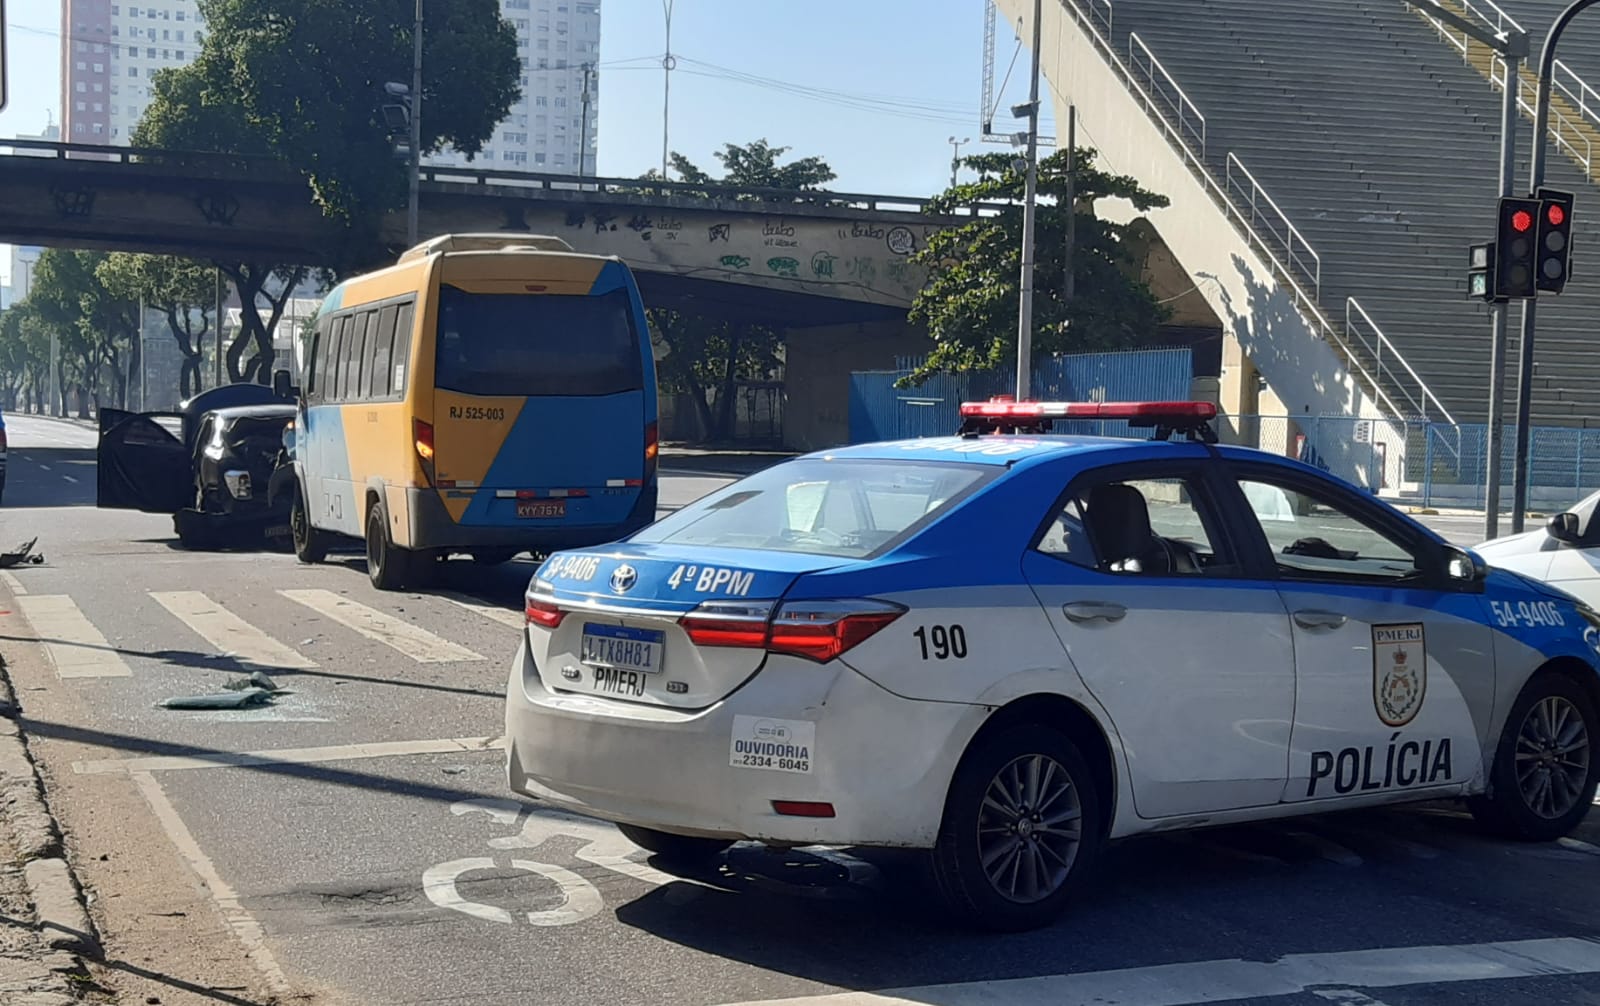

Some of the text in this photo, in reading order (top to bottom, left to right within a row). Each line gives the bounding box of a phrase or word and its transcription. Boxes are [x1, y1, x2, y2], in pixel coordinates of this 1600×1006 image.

[449, 406, 505, 421] RJ 525-003
[543, 555, 601, 582] 54-9406
[695, 566, 755, 597] BPM
[1490, 600, 1566, 628] 54-9406
[912, 623, 968, 661] 190
[1376, 628, 1421, 642] PMERJ
[586, 637, 653, 668] LTX8H81
[593, 667, 647, 697] PMERJ
[735, 739, 809, 760] OUVIDORIA
[742, 754, 809, 772] 2334-6045
[1305, 730, 1453, 798] POLÍCIA
